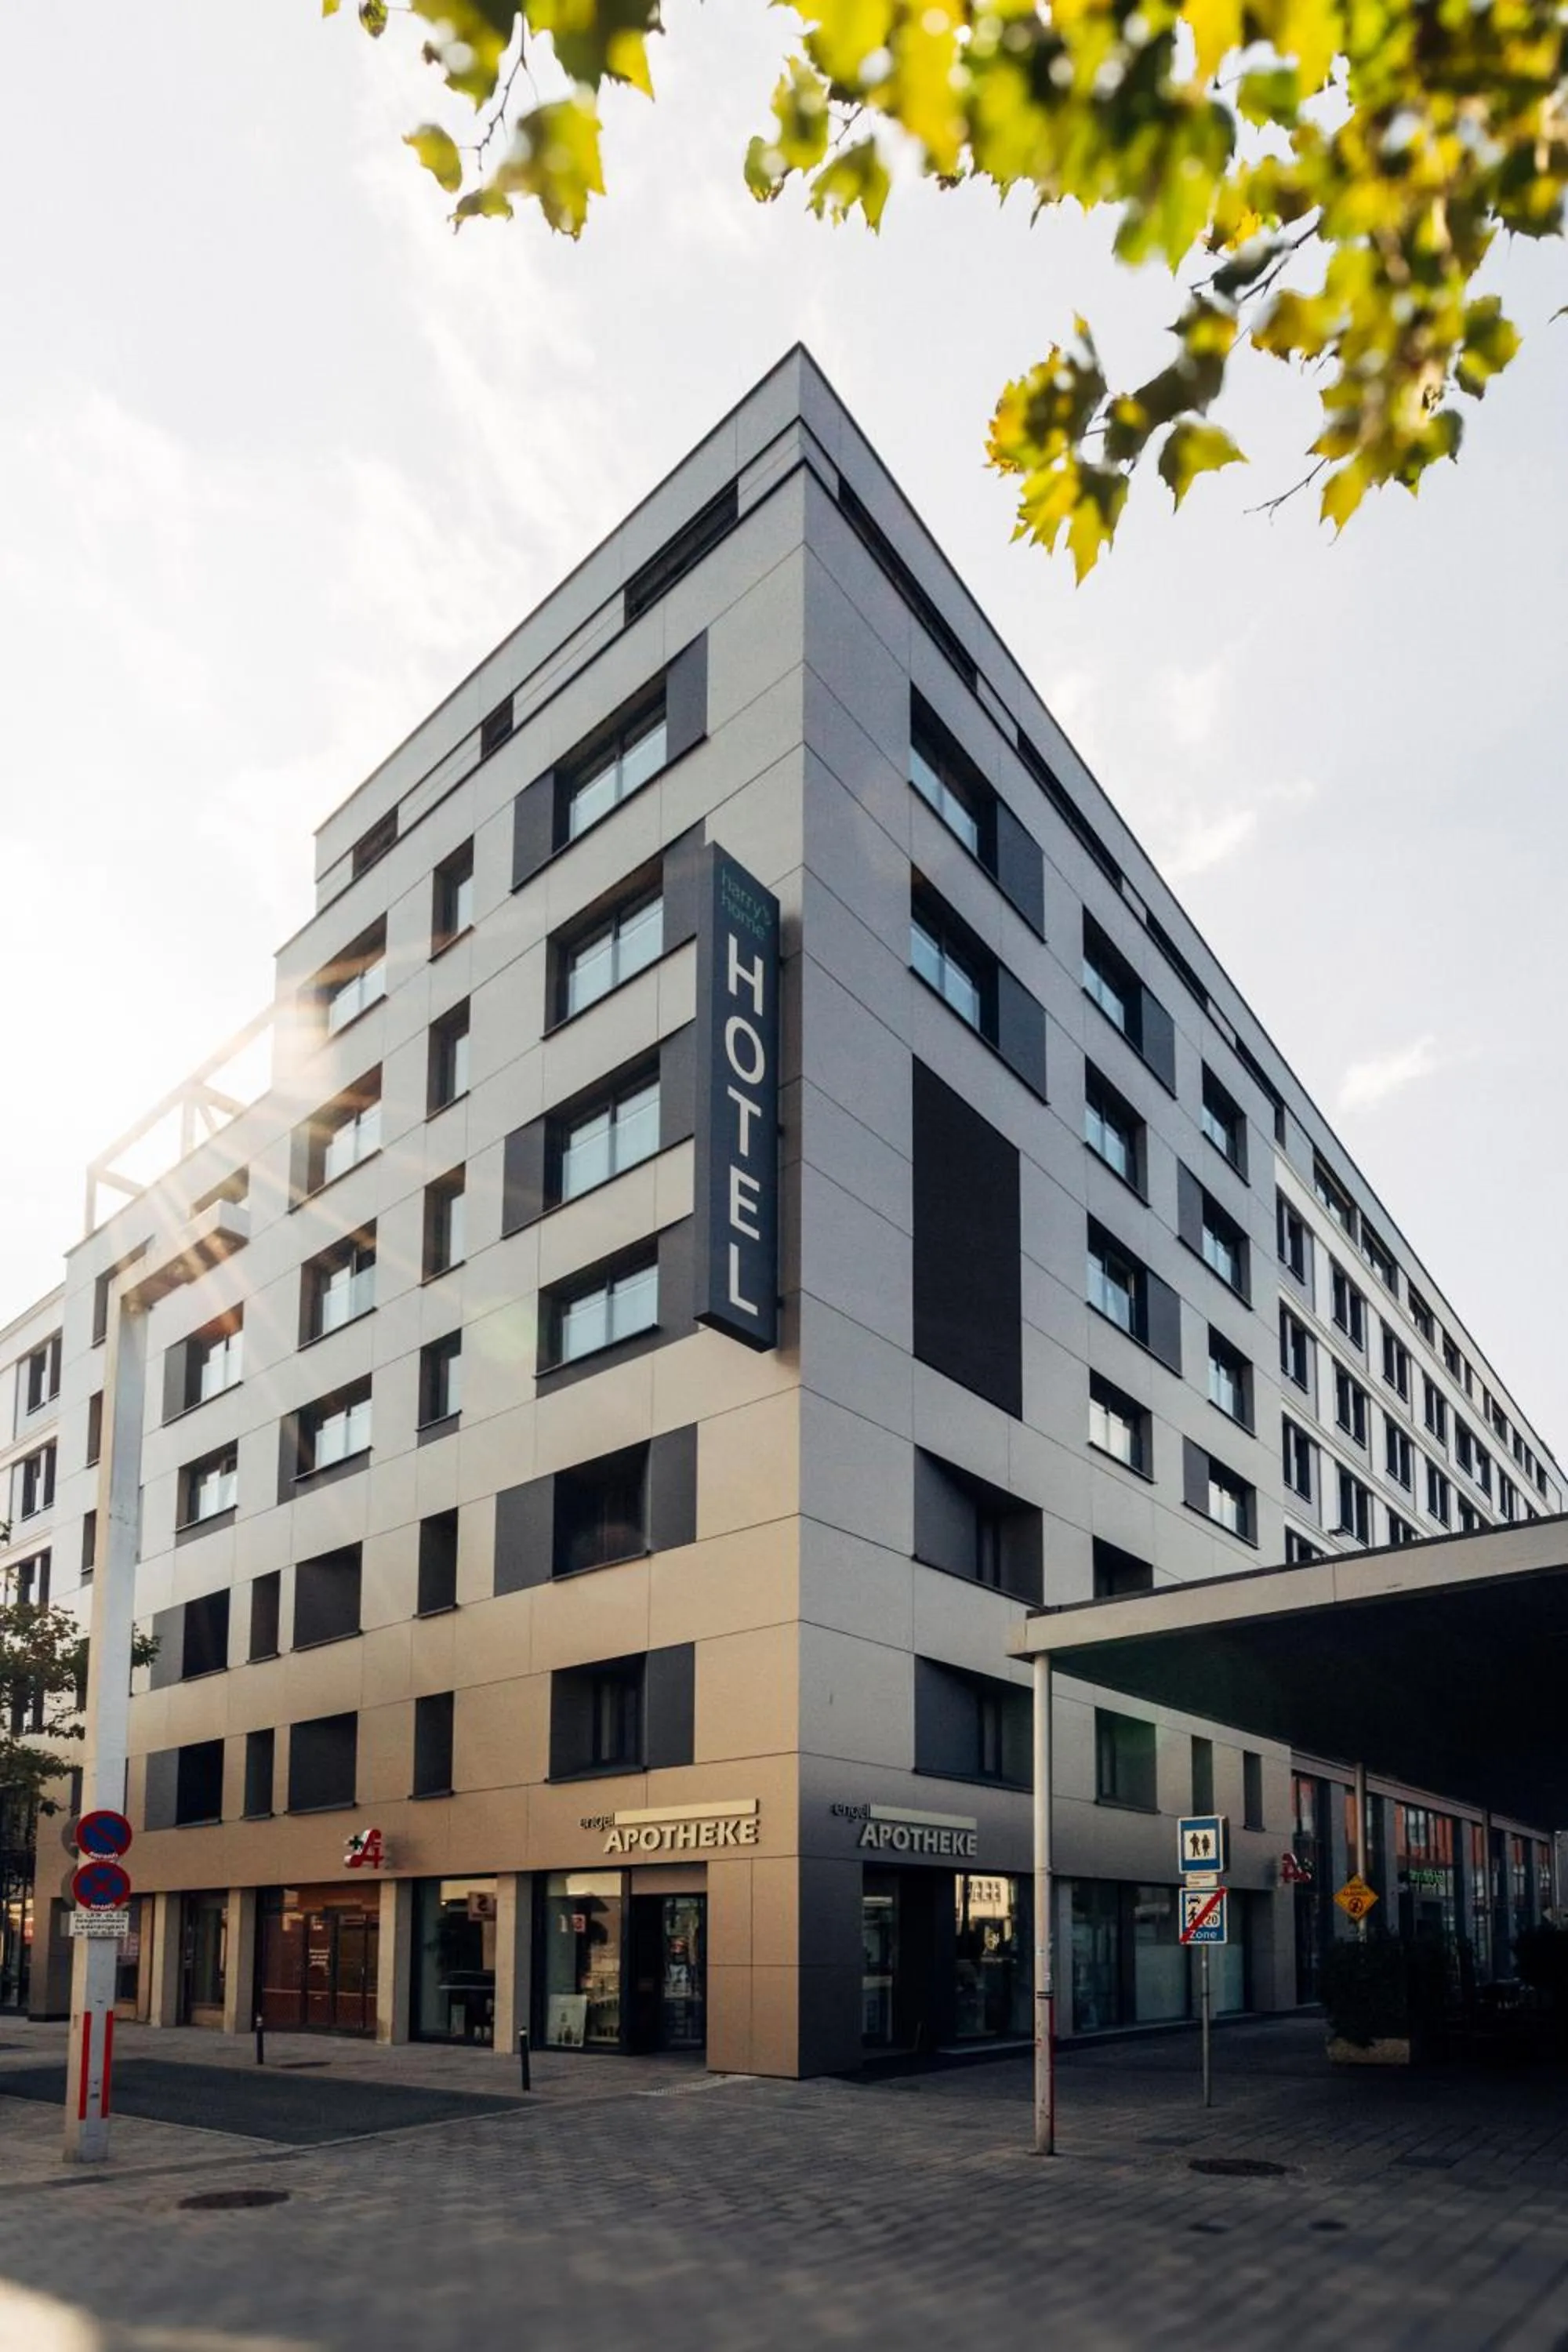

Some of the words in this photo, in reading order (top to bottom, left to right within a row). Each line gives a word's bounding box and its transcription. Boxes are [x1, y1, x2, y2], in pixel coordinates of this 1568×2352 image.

[722, 891, 766, 941] home
[725, 932, 766, 1316] HOTEL
[579, 1813, 615, 1831] engel
[603, 1819, 760, 1853] APOTHEKE
[859, 1823, 978, 1856] APOTHEKE
[1189, 1929, 1218, 1939] Zone
